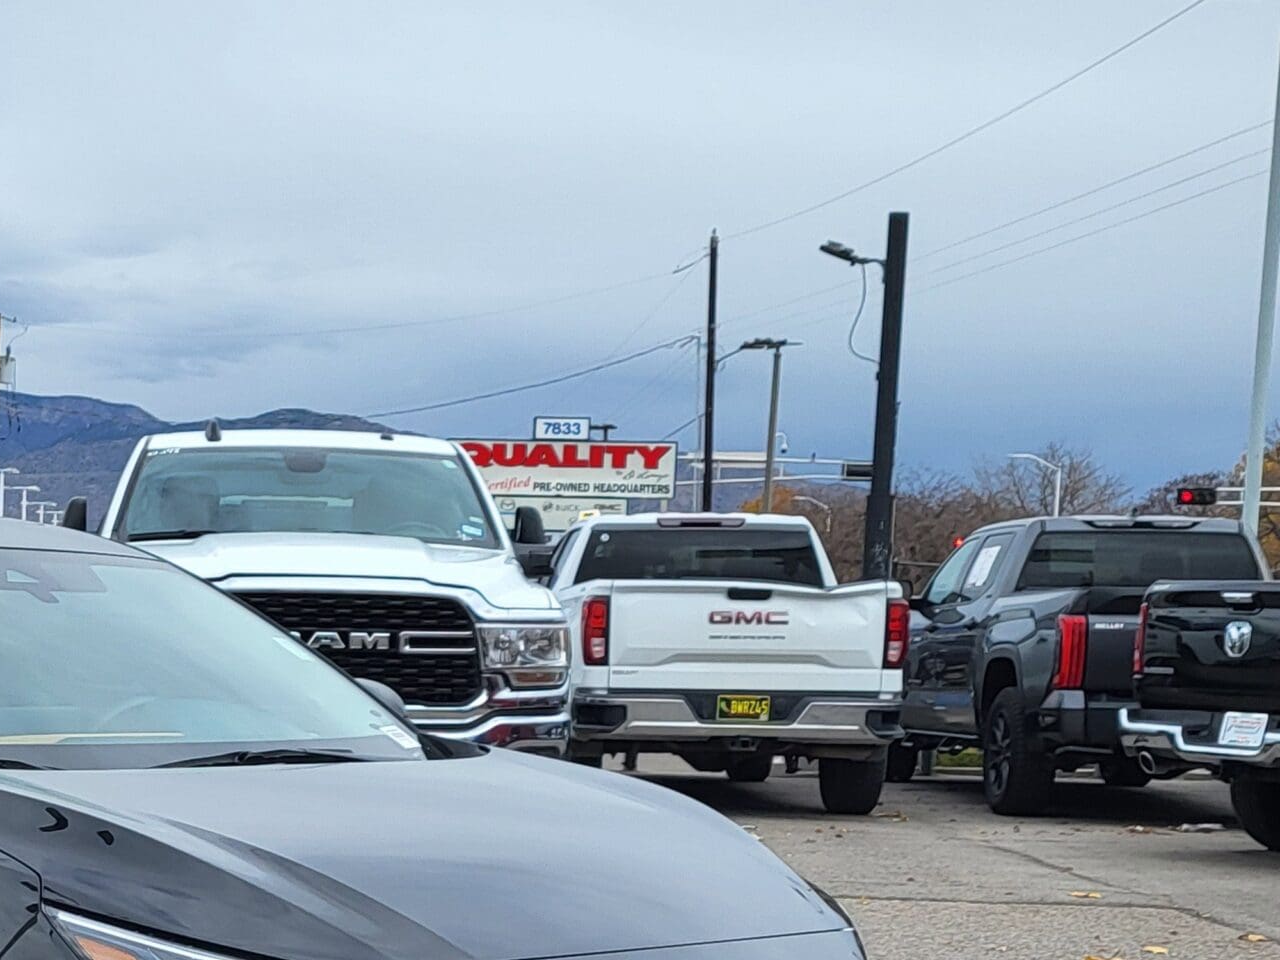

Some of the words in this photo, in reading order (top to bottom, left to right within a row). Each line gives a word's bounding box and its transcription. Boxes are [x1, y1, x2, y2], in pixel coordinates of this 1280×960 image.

[543, 421, 581, 435] 7833
[460, 442, 672, 470] QUALITY
[486, 476, 531, 491] ertified
[532, 482, 590, 493] PRE-OWNED
[593, 483, 670, 494] HEADQUARTERS
[708, 611, 789, 625] GMC
